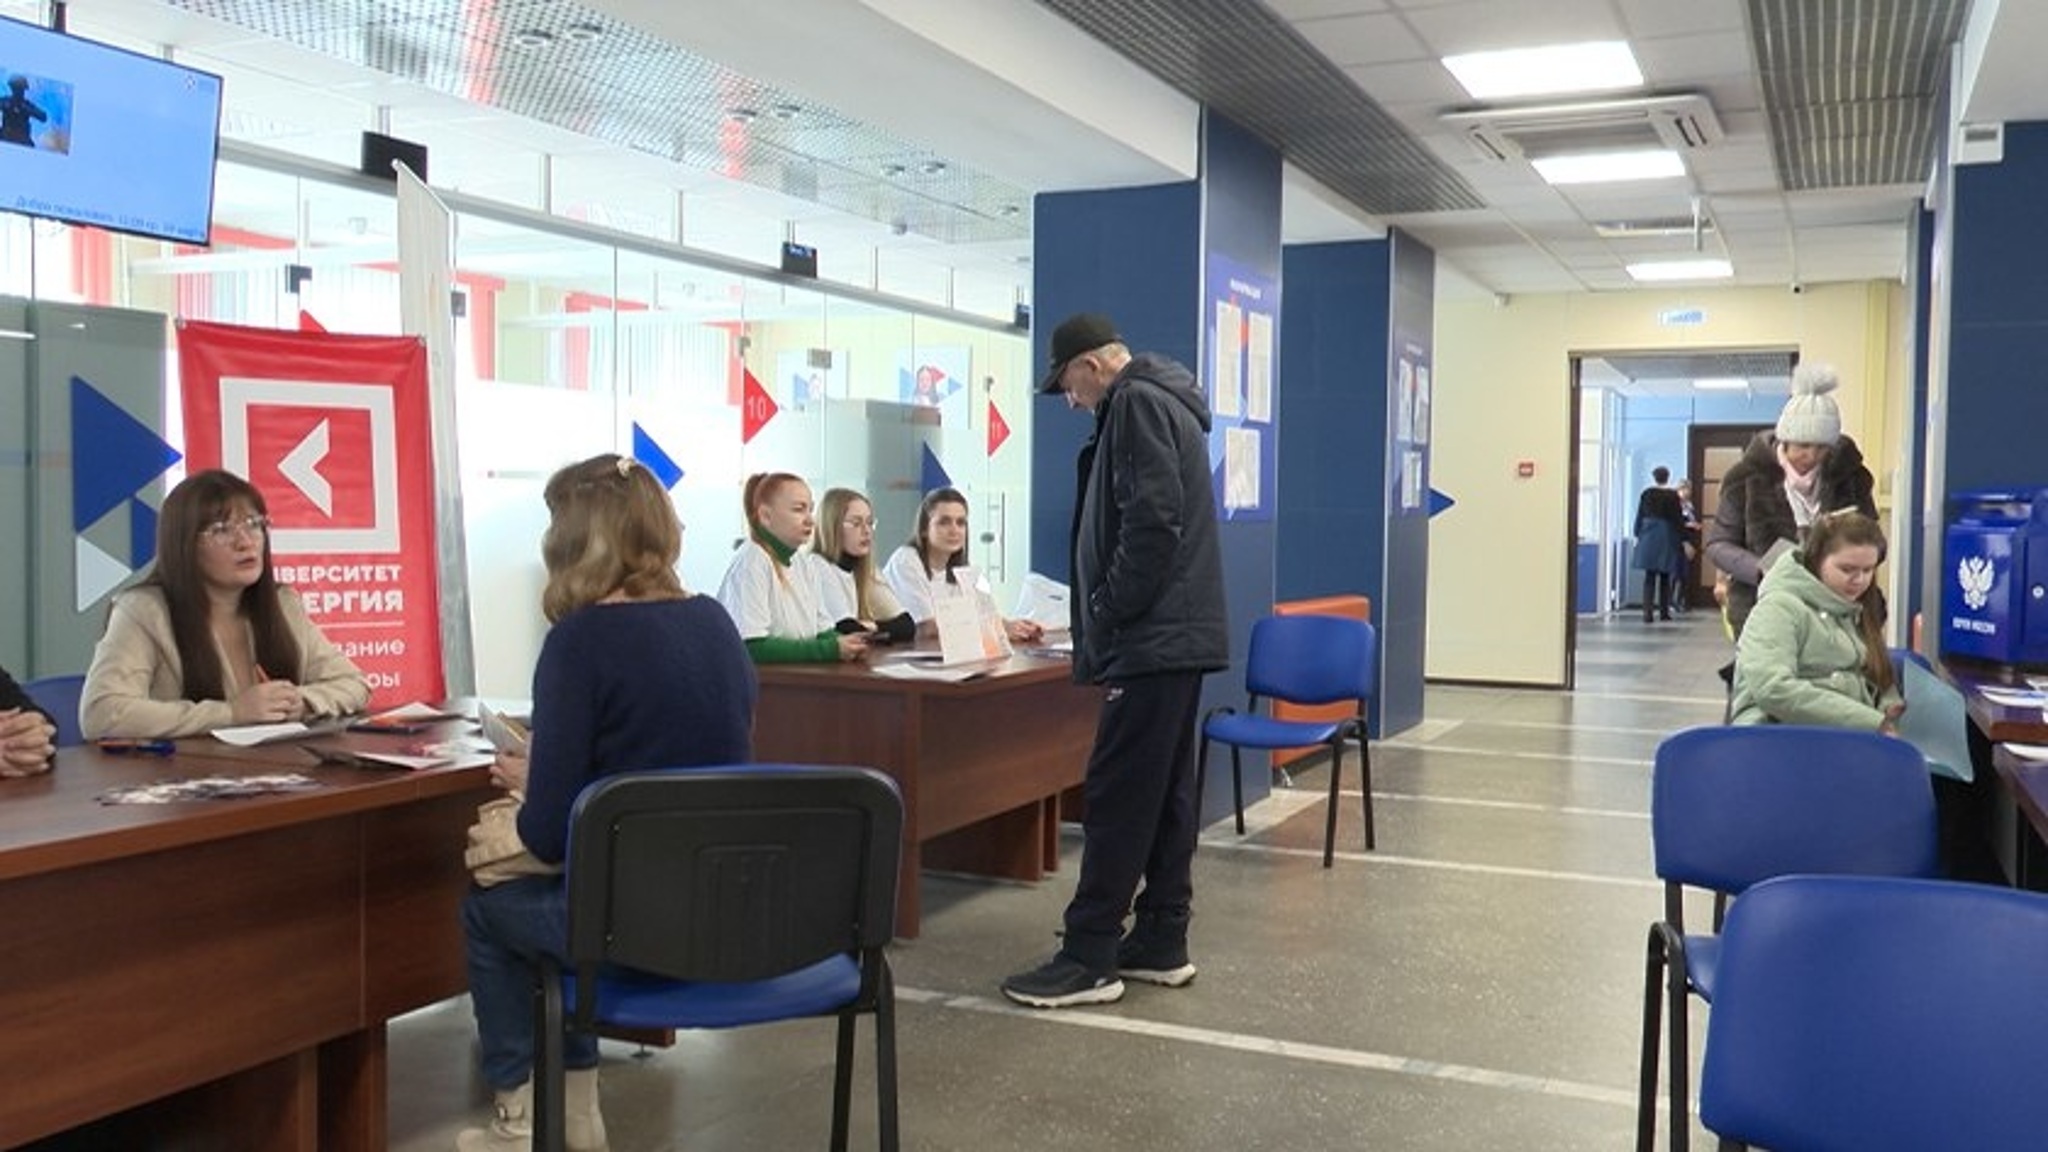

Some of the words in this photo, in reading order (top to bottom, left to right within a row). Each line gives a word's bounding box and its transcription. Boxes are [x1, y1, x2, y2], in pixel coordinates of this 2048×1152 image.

[748, 395, 767, 421] 10
[991, 421, 1002, 440] 11
[302, 591, 403, 613] ЕРГИЯ
